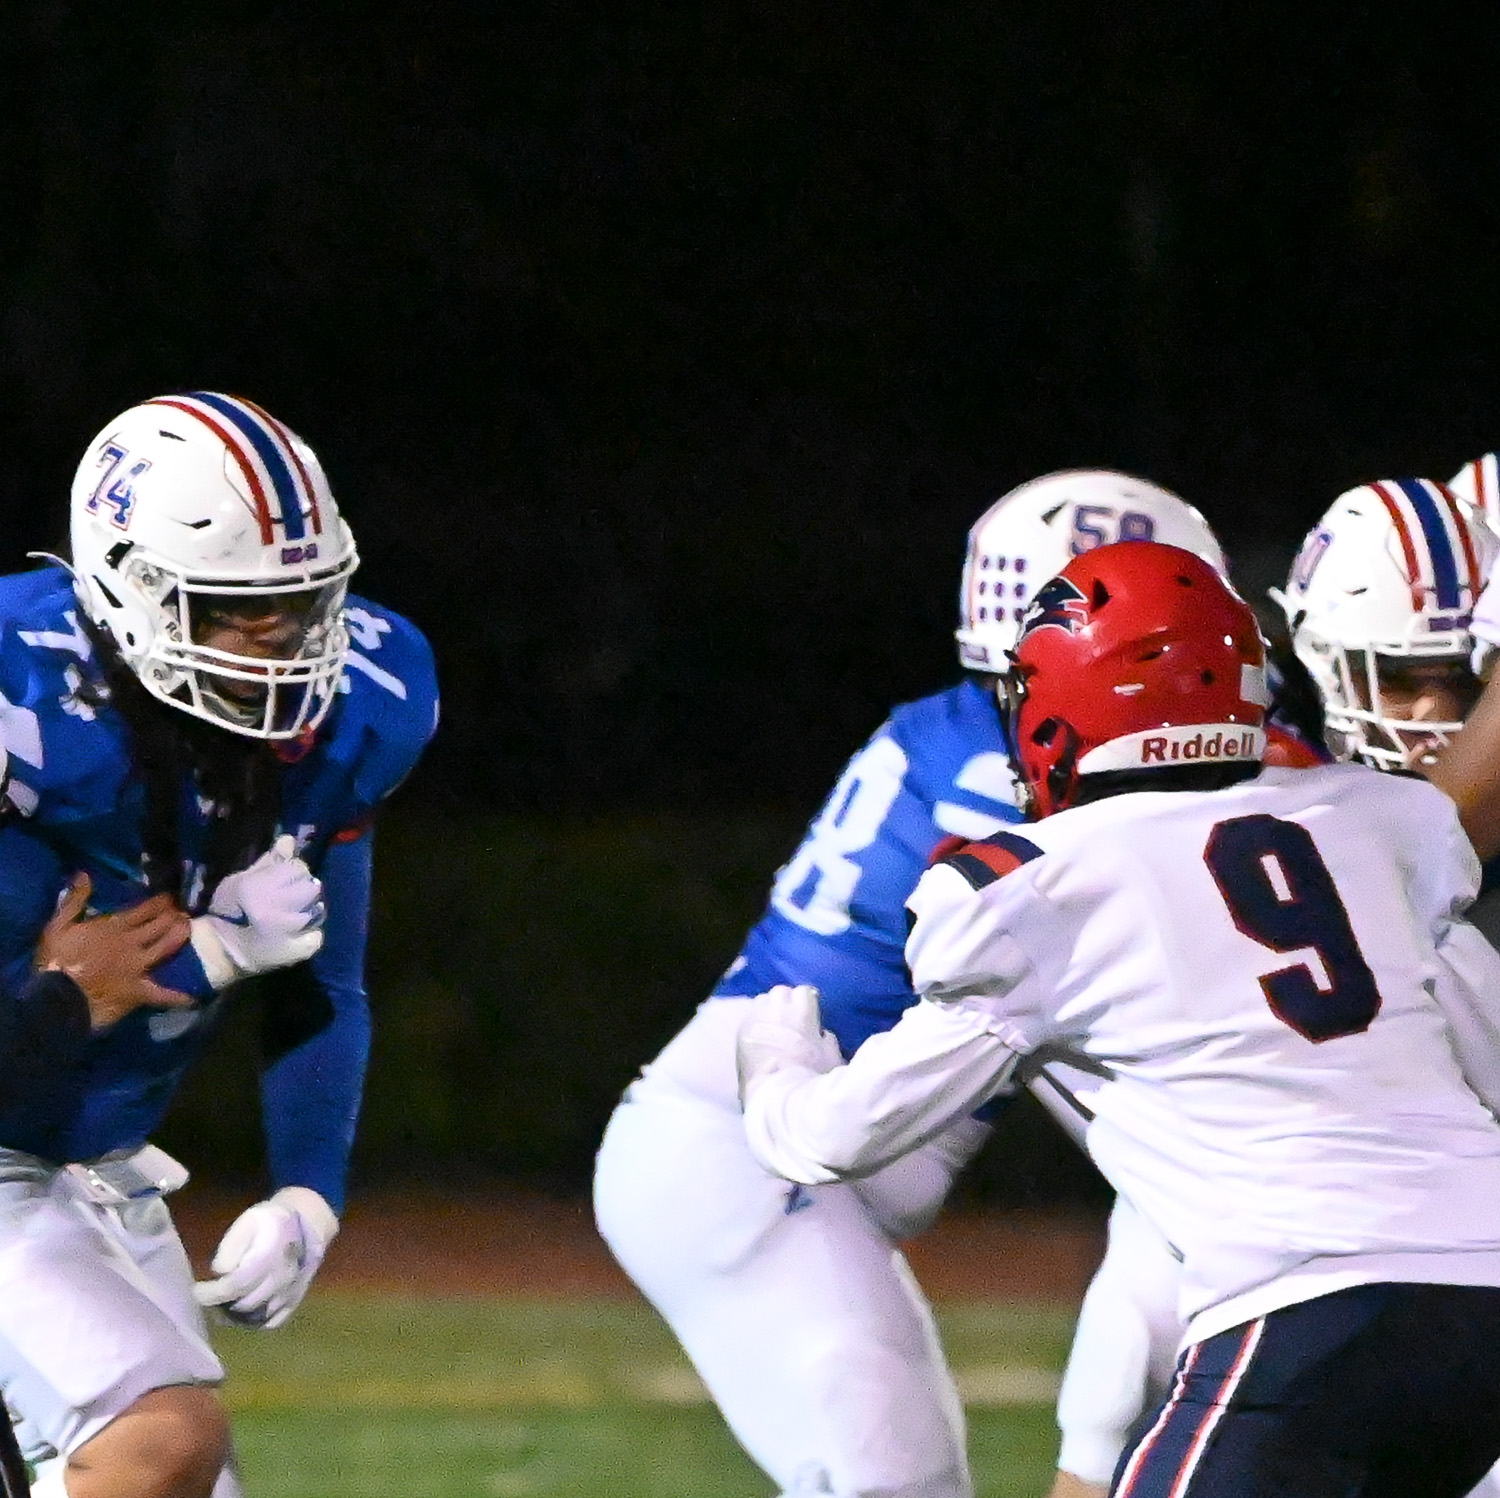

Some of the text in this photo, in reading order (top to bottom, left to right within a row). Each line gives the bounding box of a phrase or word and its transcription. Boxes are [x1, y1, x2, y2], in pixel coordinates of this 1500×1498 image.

[84, 440, 153, 532] 74
[1141, 732, 1256, 764] Riddell
[771, 736, 909, 936] 8
[1203, 814, 1383, 1044] 9
